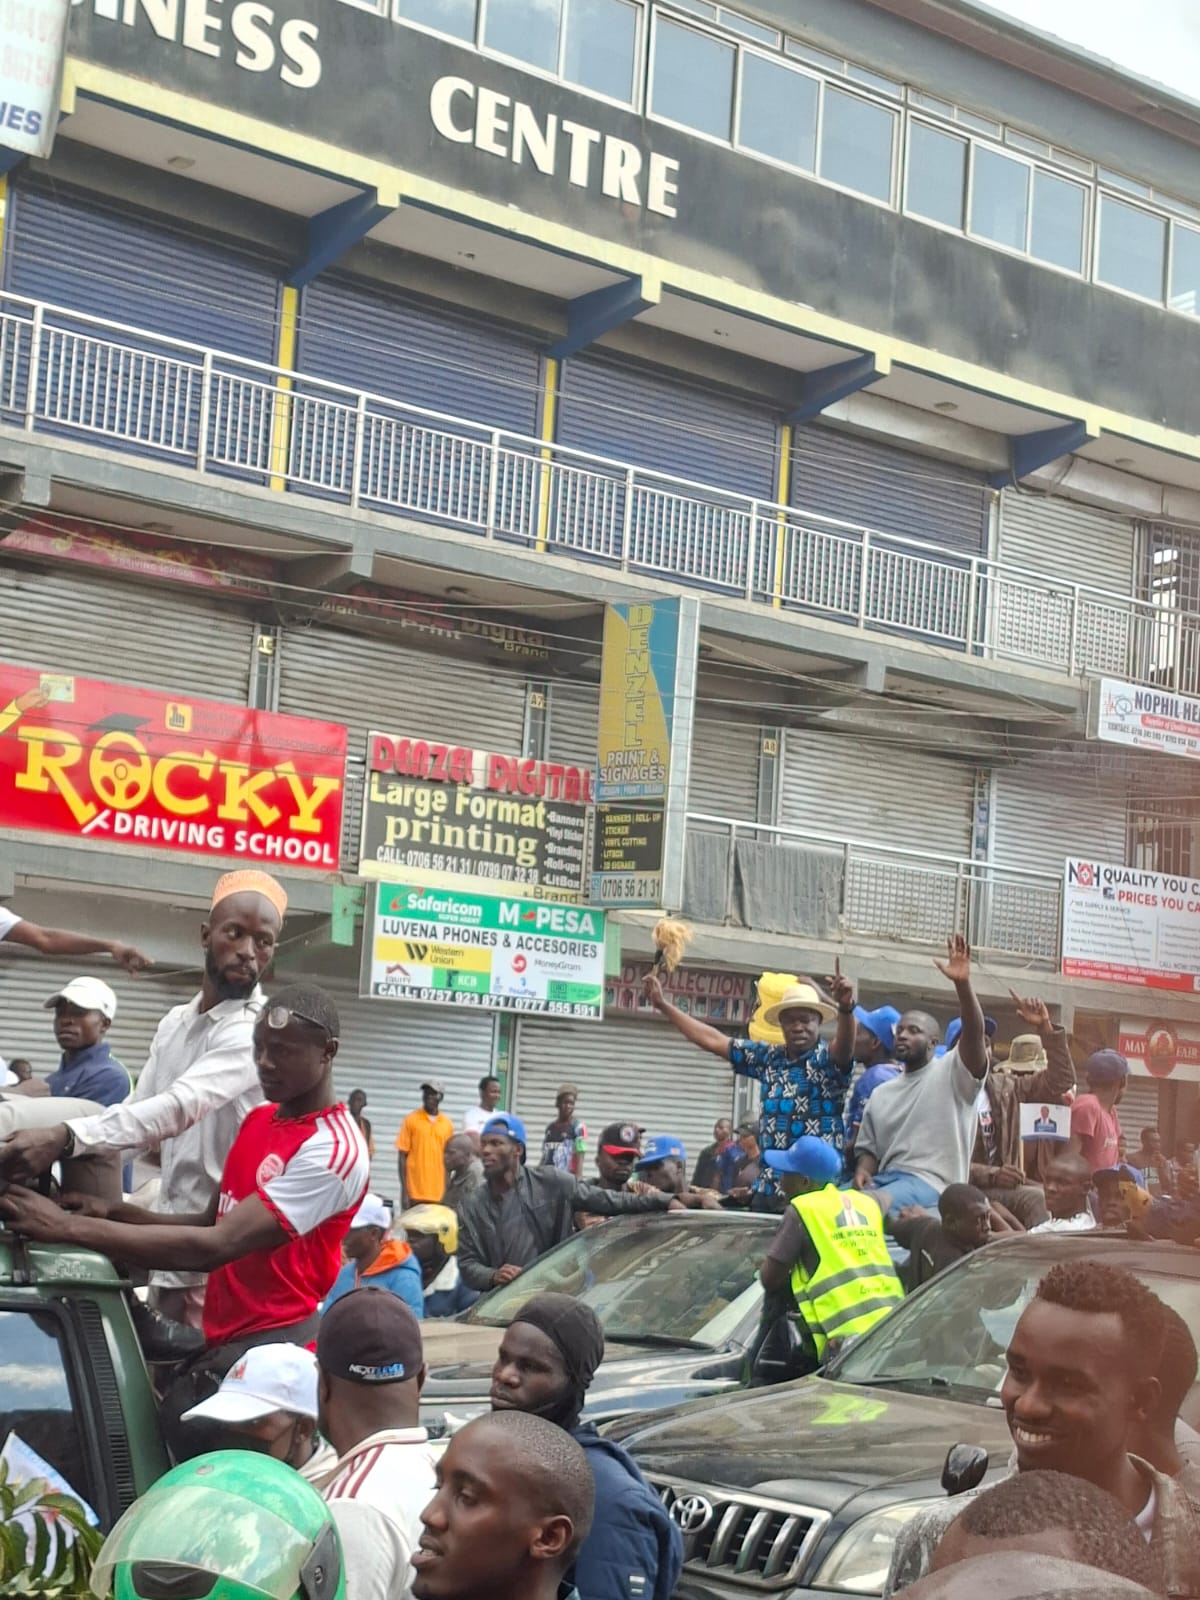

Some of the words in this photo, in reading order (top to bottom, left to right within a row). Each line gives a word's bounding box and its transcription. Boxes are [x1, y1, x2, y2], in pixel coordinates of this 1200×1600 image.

[429, 75, 680, 218] CENTRE
[624, 603, 654, 747] DENZEL
[1134, 691, 1179, 719] NOPHIL
[1183, 701, 1200, 723] HE
[607, 750, 646, 767] PRINT
[650, 748, 660, 765] &
[15, 726, 341, 833] ROCKY
[600, 764, 665, 783] SIGNAGES
[370, 772, 448, 817] Large
[455, 784, 546, 829] Format
[114, 812, 225, 848] DRIVING
[234, 830, 334, 864] SCHOOL
[384, 814, 539, 867] printing
[376, 846, 405, 864] CALL:
[406, 850, 430, 869] 0706
[431, 854, 445, 872] 56
[446, 856, 458, 873] 21
[459, 858, 472, 875] 31
[501, 864, 513, 881] 07
[513, 867, 526, 883] 32
[533, 886, 580, 905] Brand
[602, 879, 623, 897] 0706
[623, 879, 636, 897] 56
[637, 879, 648, 897] 21
[649, 879, 661, 897] 31
[1103, 868, 1158, 888] QUALITY
[1162, 877, 1187, 893] YOU
[1191, 883, 1200, 896] C
[407, 892, 483, 917] Safaricom
[1118, 889, 1157, 907] PRICES
[1161, 896, 1184, 911] YOU
[382, 919, 438, 940] LUVENA
[442, 927, 498, 947] PHONES
[502, 934, 511, 948] &
[516, 937, 598, 959] ACCESORIES
[431, 945, 465, 958] Western
[430, 955, 455, 966] Union
[457, 975, 478, 988] KCB
[643, 970, 745, 996] OLLECTION
[378, 983, 417, 1000] CALL:
[419, 988, 450, 1002] 0757
[515, 998, 546, 1013] 0777
[549, 1002, 572, 1015] 555
[1125, 1040, 1147, 1054] MAY
[1176, 1046, 1198, 1057] FAIR
